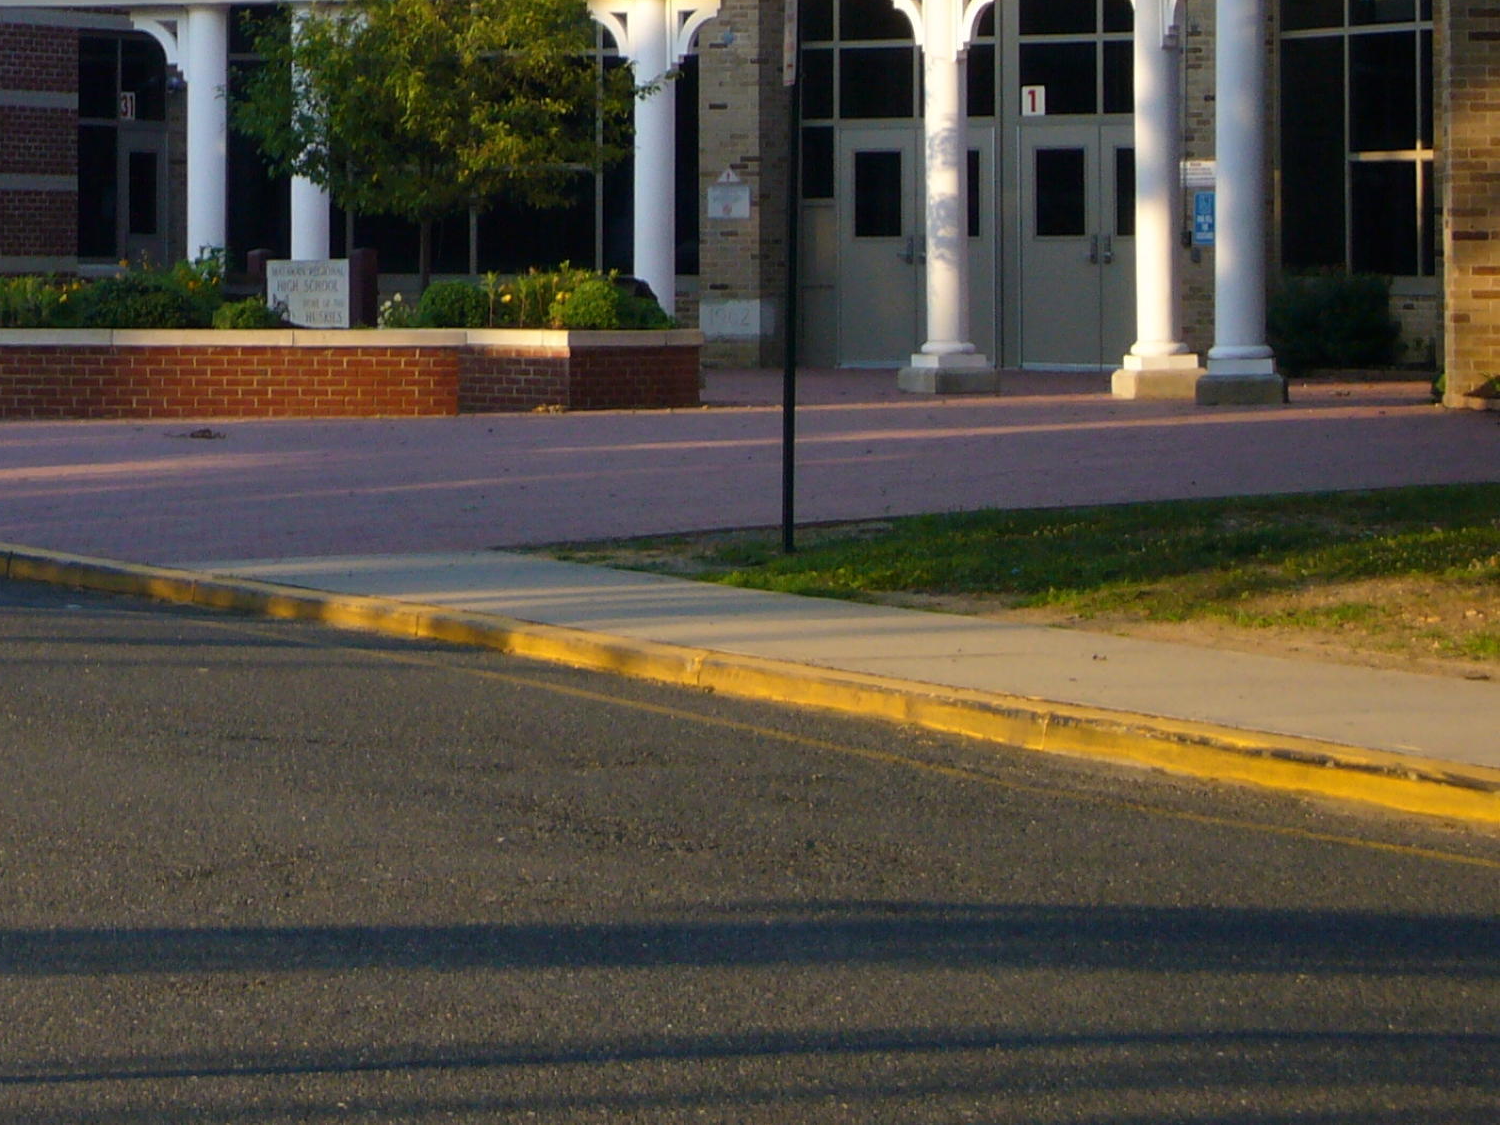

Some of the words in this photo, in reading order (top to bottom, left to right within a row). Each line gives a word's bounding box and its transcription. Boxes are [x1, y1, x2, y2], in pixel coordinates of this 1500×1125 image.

[1028, 89, 1037, 113] 1
[277, 278, 299, 292] HIGH
[303, 278, 339, 293] SCHOOL
